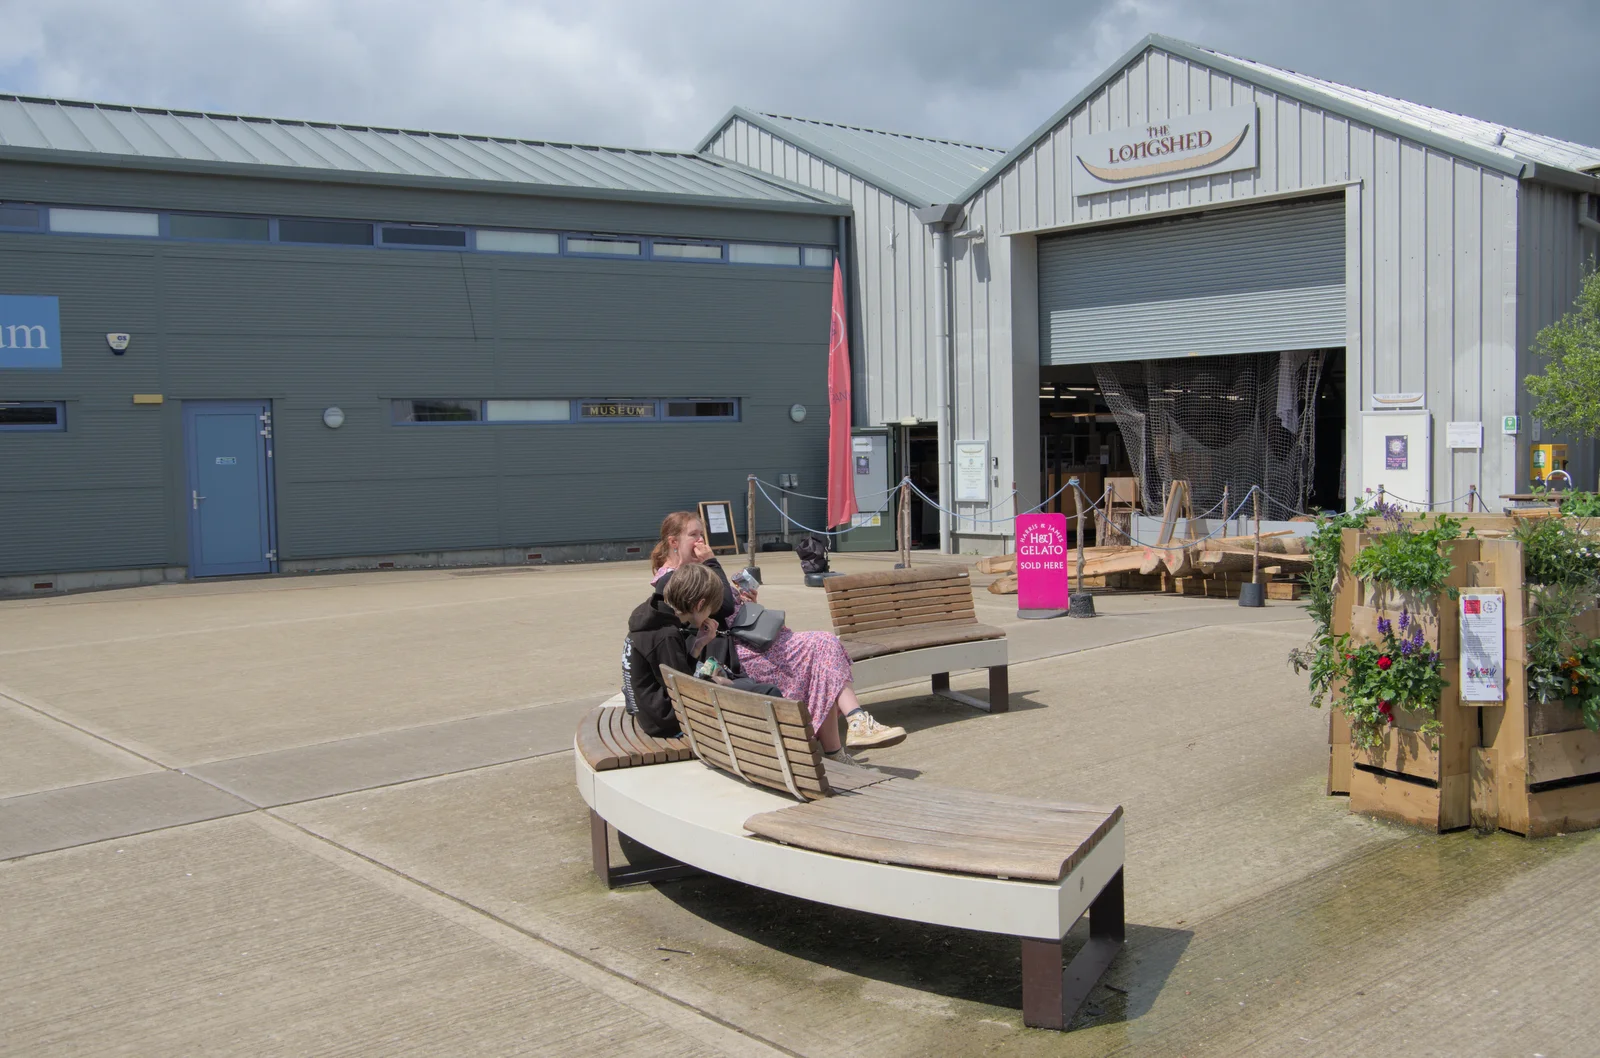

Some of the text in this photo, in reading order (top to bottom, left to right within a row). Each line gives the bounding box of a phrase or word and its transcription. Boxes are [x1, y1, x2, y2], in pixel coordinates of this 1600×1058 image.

[1146, 124, 1170, 139] THE
[1108, 130, 1213, 164] LONGSHED
[590, 406, 645, 416] MUSEUM
[1020, 523, 1038, 543] HARRIS
[1047, 525, 1063, 542] JAMES
[1030, 532, 1053, 545] H&J
[1020, 545, 1063, 555] GELATO
[1020, 561, 1064, 570] SOLD HERE
